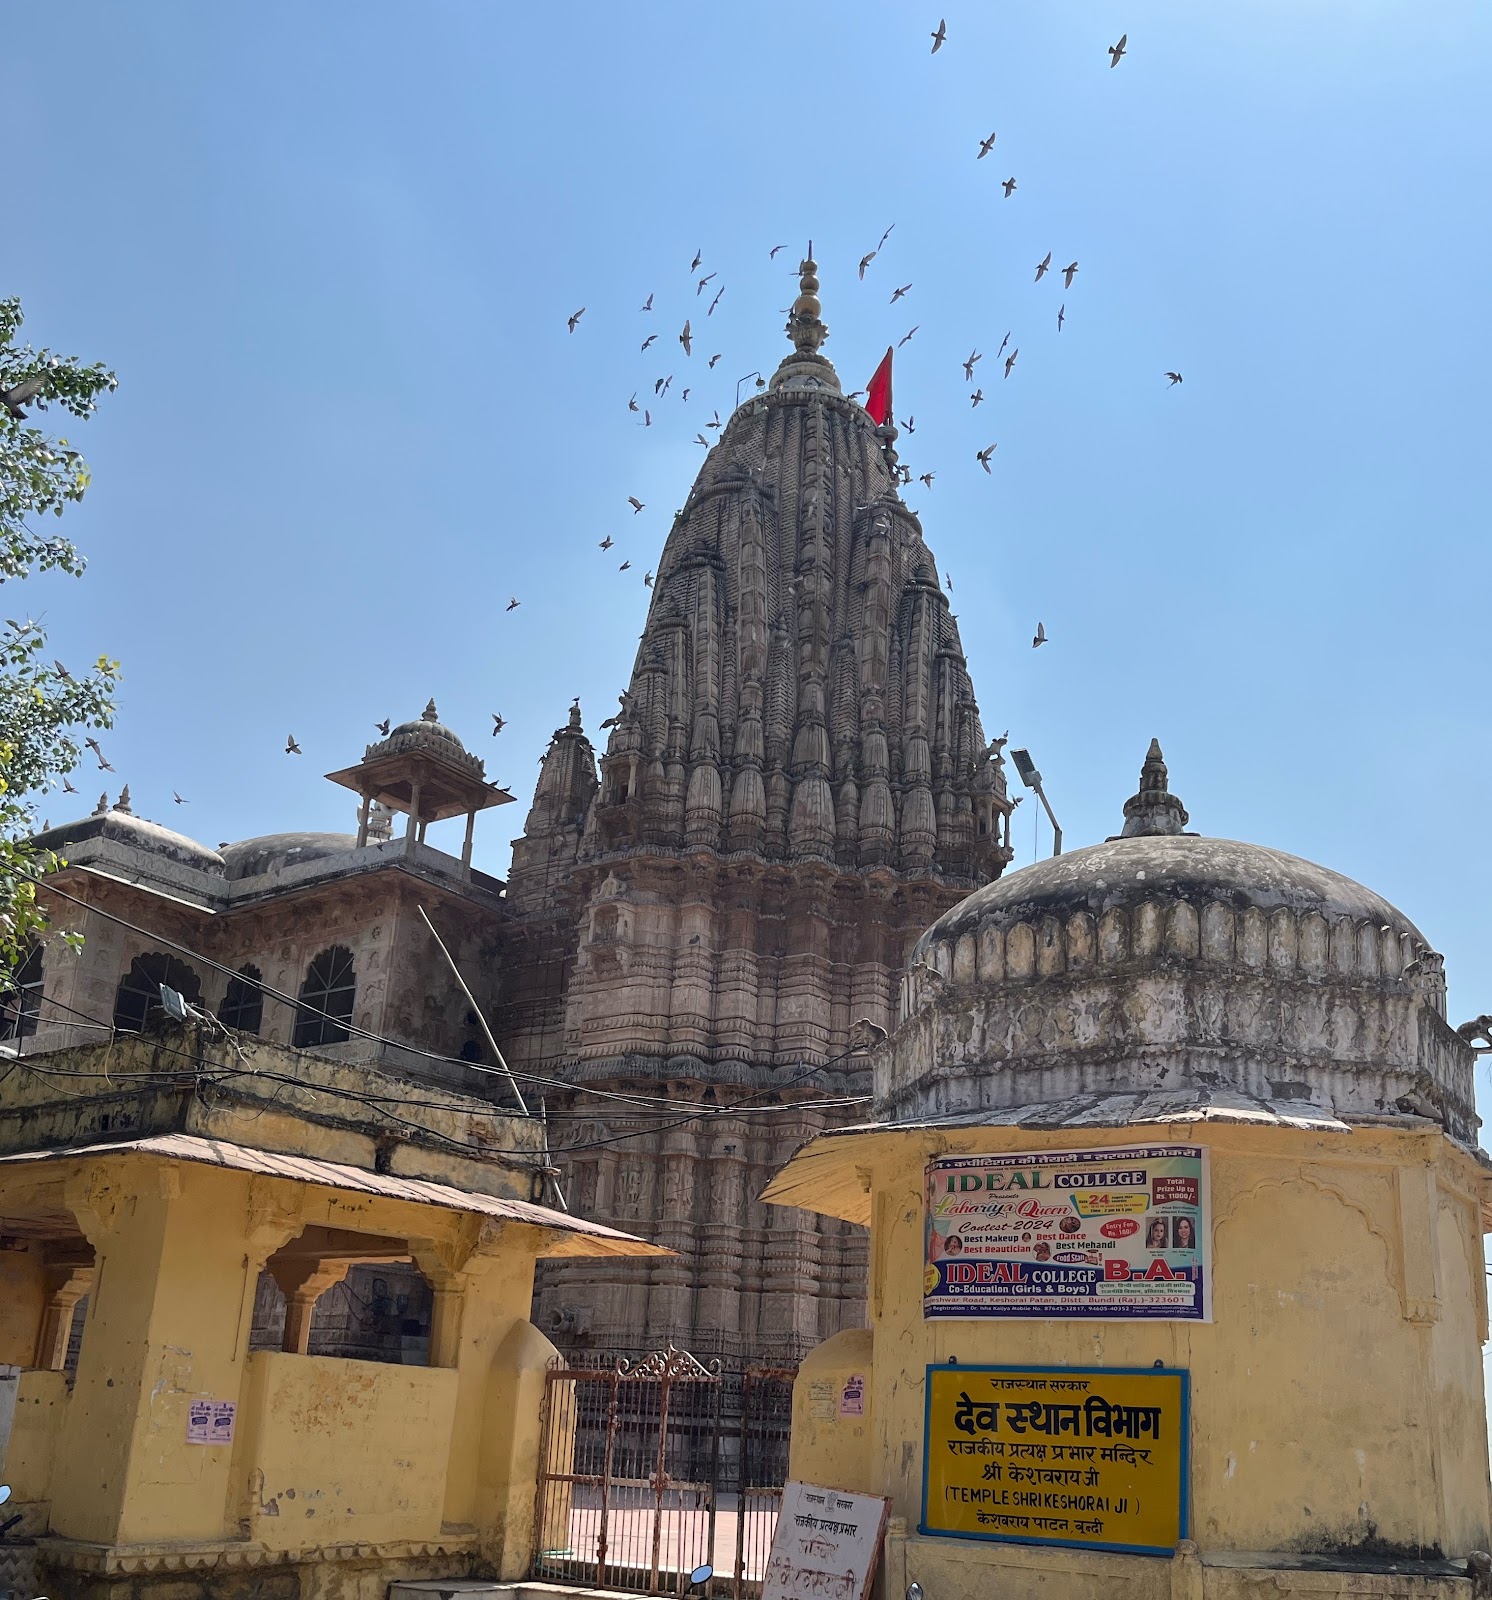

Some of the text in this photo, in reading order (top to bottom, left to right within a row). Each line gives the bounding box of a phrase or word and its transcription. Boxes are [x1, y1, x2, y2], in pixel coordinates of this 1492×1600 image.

[946, 1170, 1144, 1192] IDEAL COLLEGE
[934, 1194, 1069, 1218] Lahariya Queen
[1089, 1195, 1108, 1204] 24
[958, 1220, 1054, 1233] Contest-2024
[985, 1235, 1019, 1243] Makeup
[1056, 1241, 1116, 1250] Best Mehandi
[985, 1245, 1031, 1253] Beautician
[1056, 1254, 1070, 1262] Food
[1071, 1253, 1085, 1261] Stall
[946, 1262, 1028, 1283] IDEAL
[1032, 1270, 1096, 1283] COLLEGE
[1104, 1258, 1186, 1280] B.A.
[948, 1285, 1008, 1294] Co-Education
[1012, 1285, 1042, 1295] (Girls
[1058, 1284, 1090, 1294] Boys)
[1119, 1296, 1185, 1304] (Raj.)-323601
[990, 1379, 1090, 1393] राजस्थान सरकार
[954, 1392, 1162, 1440] देव स्थान विभाग
[947, 1438, 1005, 1457] राजकीय
[1008, 1443, 1047, 1462] प्रत्यक्ष
[1100, 1443, 1154, 1468] मन्दिर
[982, 1461, 1003, 1481] श्री
[1083, 1466, 1100, 1486] जी
[946, 1486, 1009, 1505] (TEMPLE
[836, 1499, 853, 1511] सरकार
[977, 1510, 1030, 1529] केशवराय
[820, 1520, 838, 1535] प्रत्यक्ष
[840, 1523, 858, 1537] प्रभार
